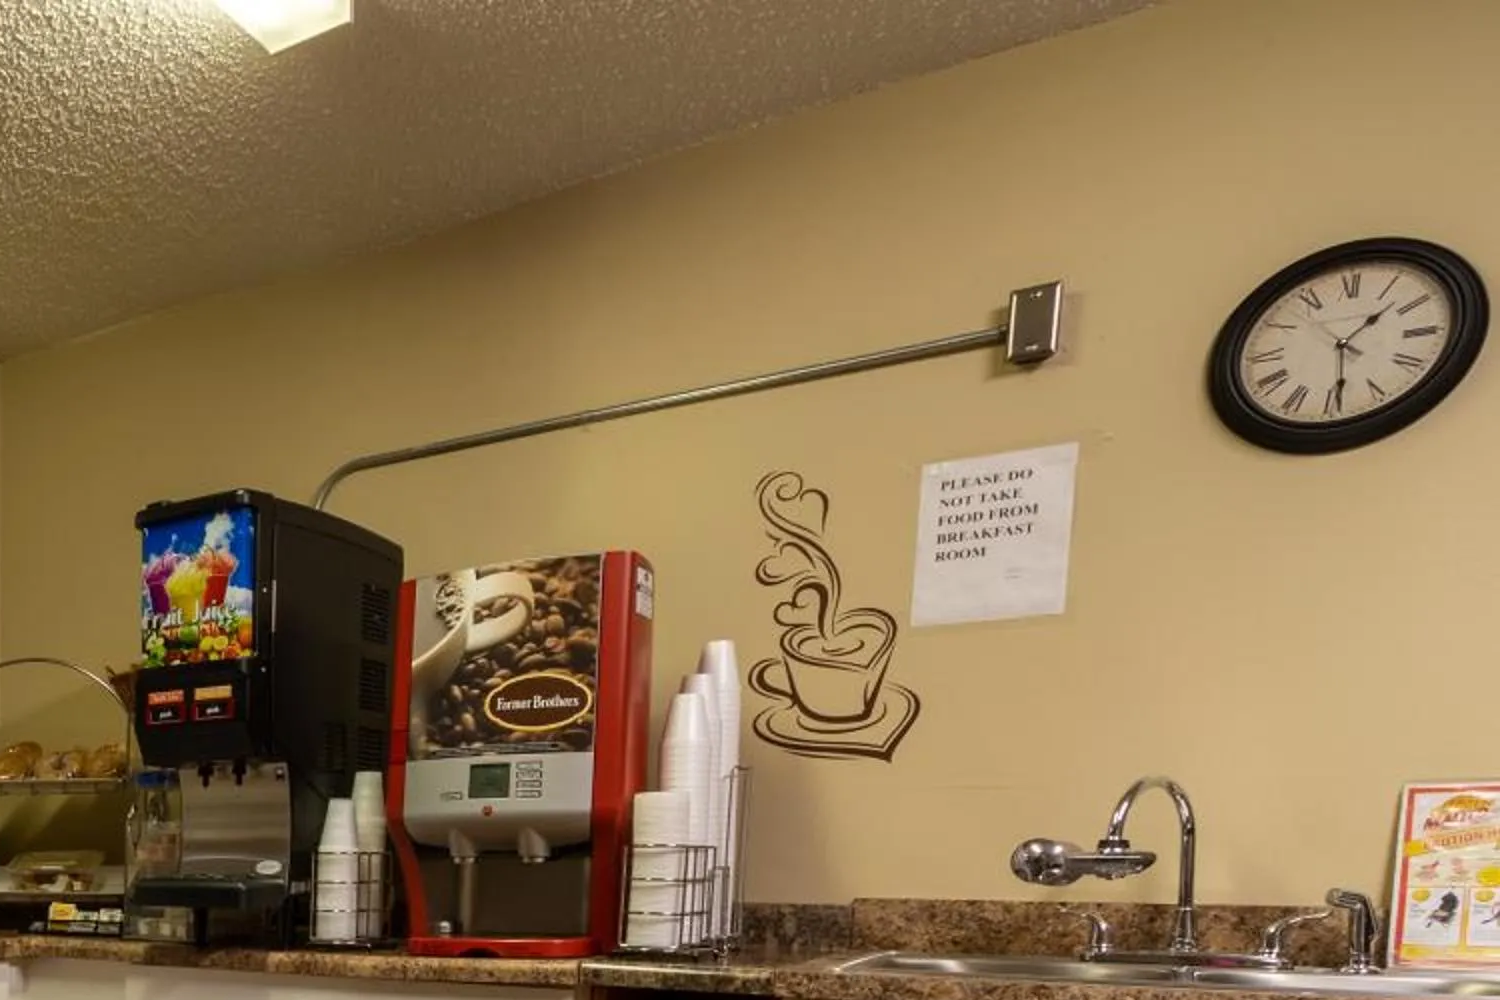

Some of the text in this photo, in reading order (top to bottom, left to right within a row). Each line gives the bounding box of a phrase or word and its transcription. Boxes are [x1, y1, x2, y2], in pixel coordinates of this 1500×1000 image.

[941, 469, 1033, 491] PLEASE DO
[940, 488, 1022, 508] NOT TAKE
[938, 503, 1040, 527] FOOD FROM
[936, 523, 1033, 545] BREAKFAST
[934, 546, 987, 563] ROOM
[496, 694, 581, 712] Farmer Brothers
